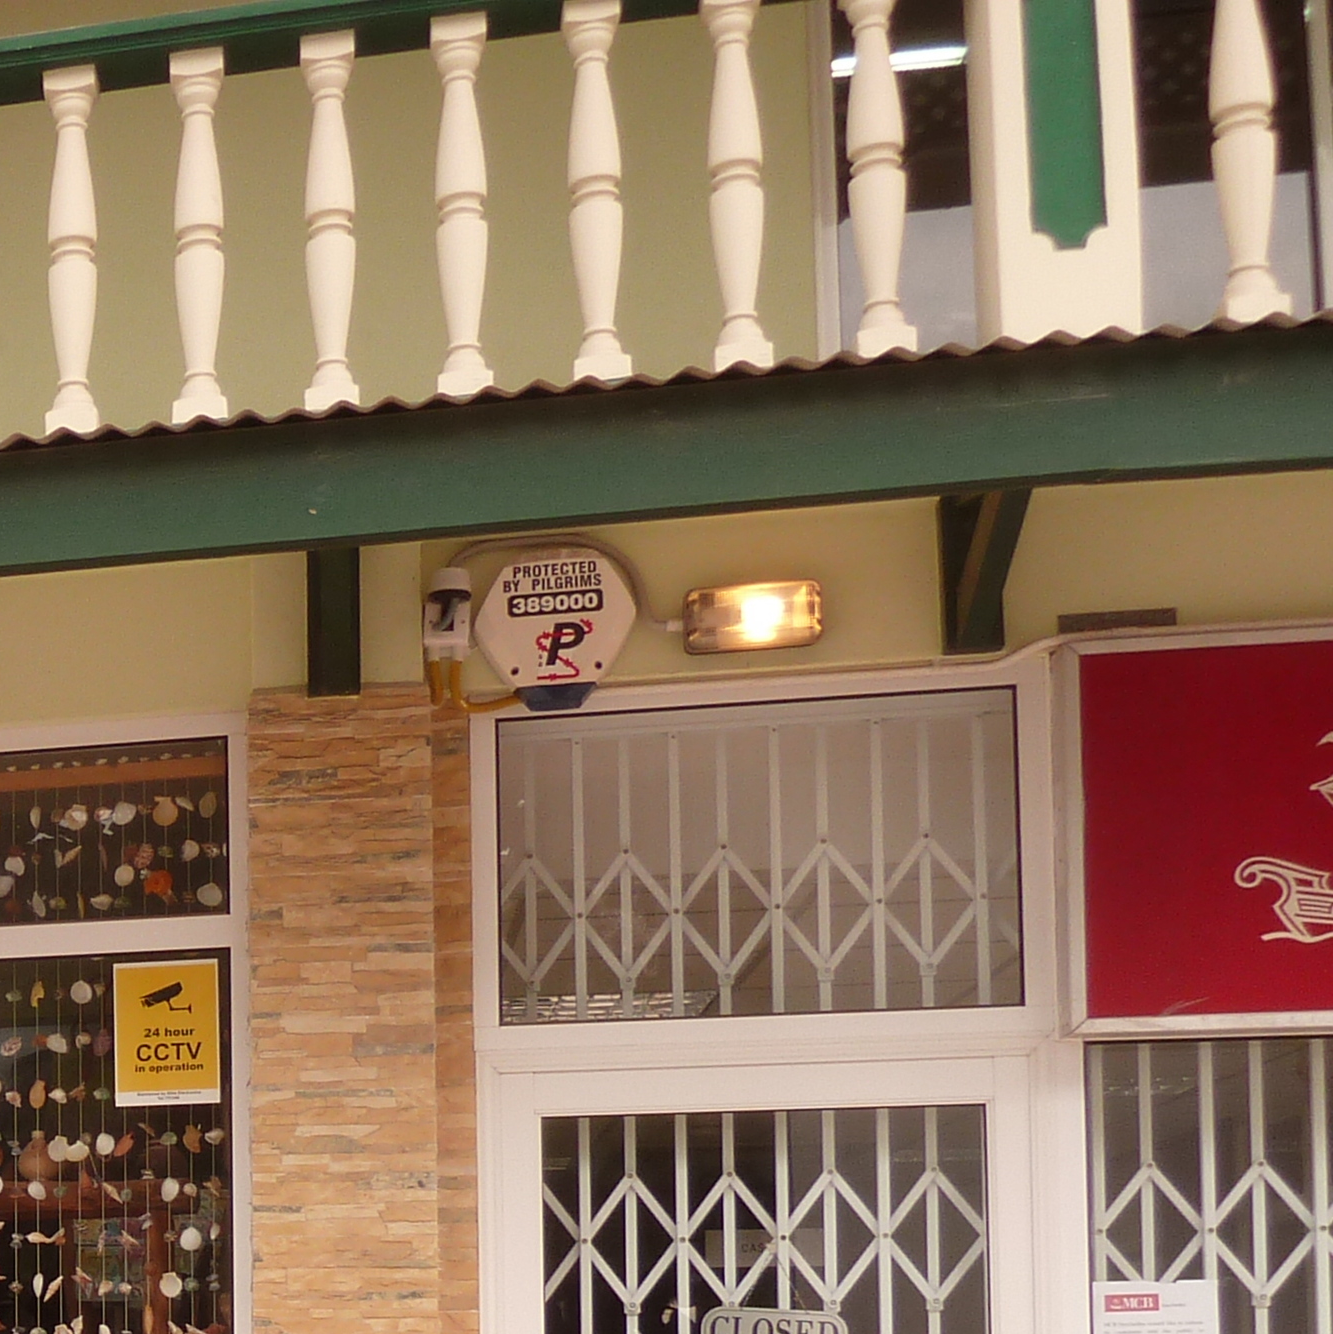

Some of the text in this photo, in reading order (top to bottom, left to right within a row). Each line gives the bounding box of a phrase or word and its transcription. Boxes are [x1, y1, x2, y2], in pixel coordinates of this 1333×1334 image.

[512, 560, 597, 580] PROTECTED
[503, 573, 602, 593] BY PILGRIMS
[512, 593, 598, 615] 389000
[144, 1027, 195, 1038] 24 hour
[136, 1041, 202, 1062] CCTV
[135, 1062, 204, 1074] in operation
[741, 1243, 765, 1253] CAS
[1122, 1297, 1153, 1309] MCB
